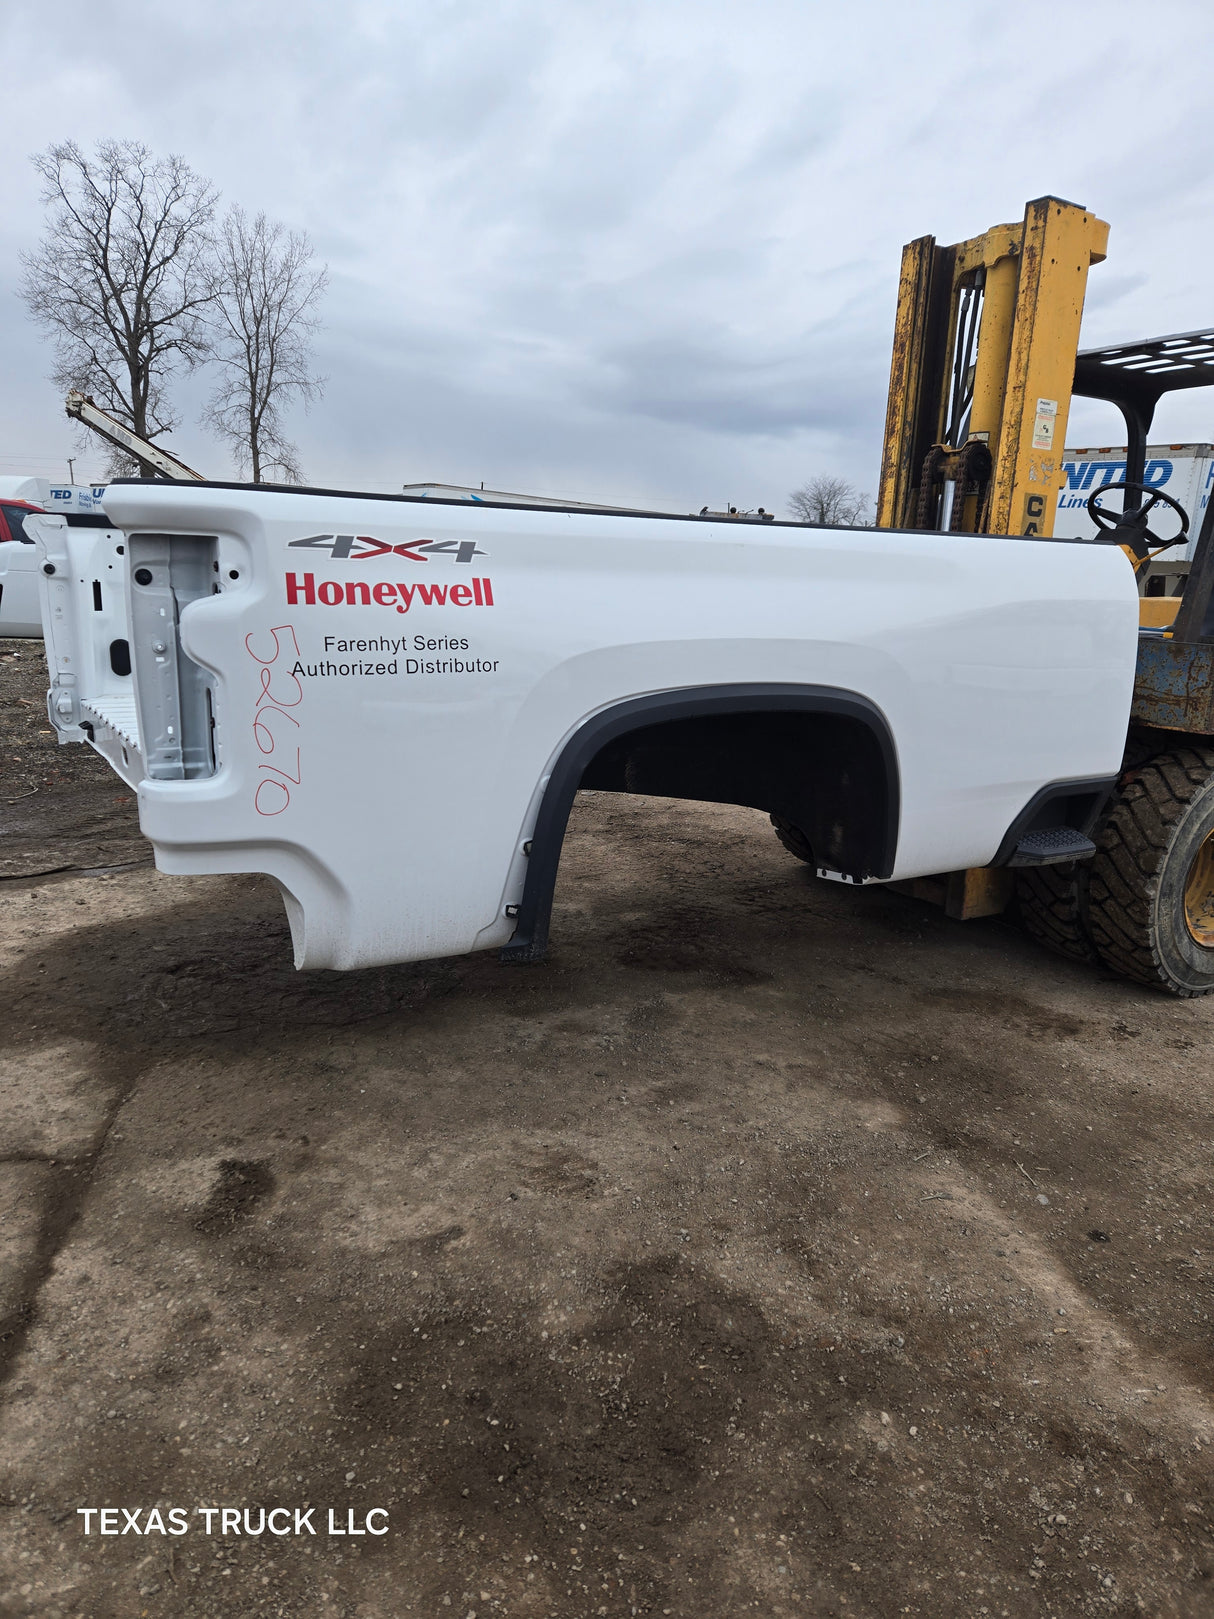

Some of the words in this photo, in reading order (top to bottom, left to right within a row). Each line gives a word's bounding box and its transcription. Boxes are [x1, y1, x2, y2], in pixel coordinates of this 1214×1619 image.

[1057, 494, 1104, 509] Lines
[285, 572, 495, 614] Honeywell
[324, 636, 408, 654] Farenhyt
[413, 635, 470, 651] Series
[292, 659, 399, 677] Authorized
[406, 658, 500, 674] Distributor
